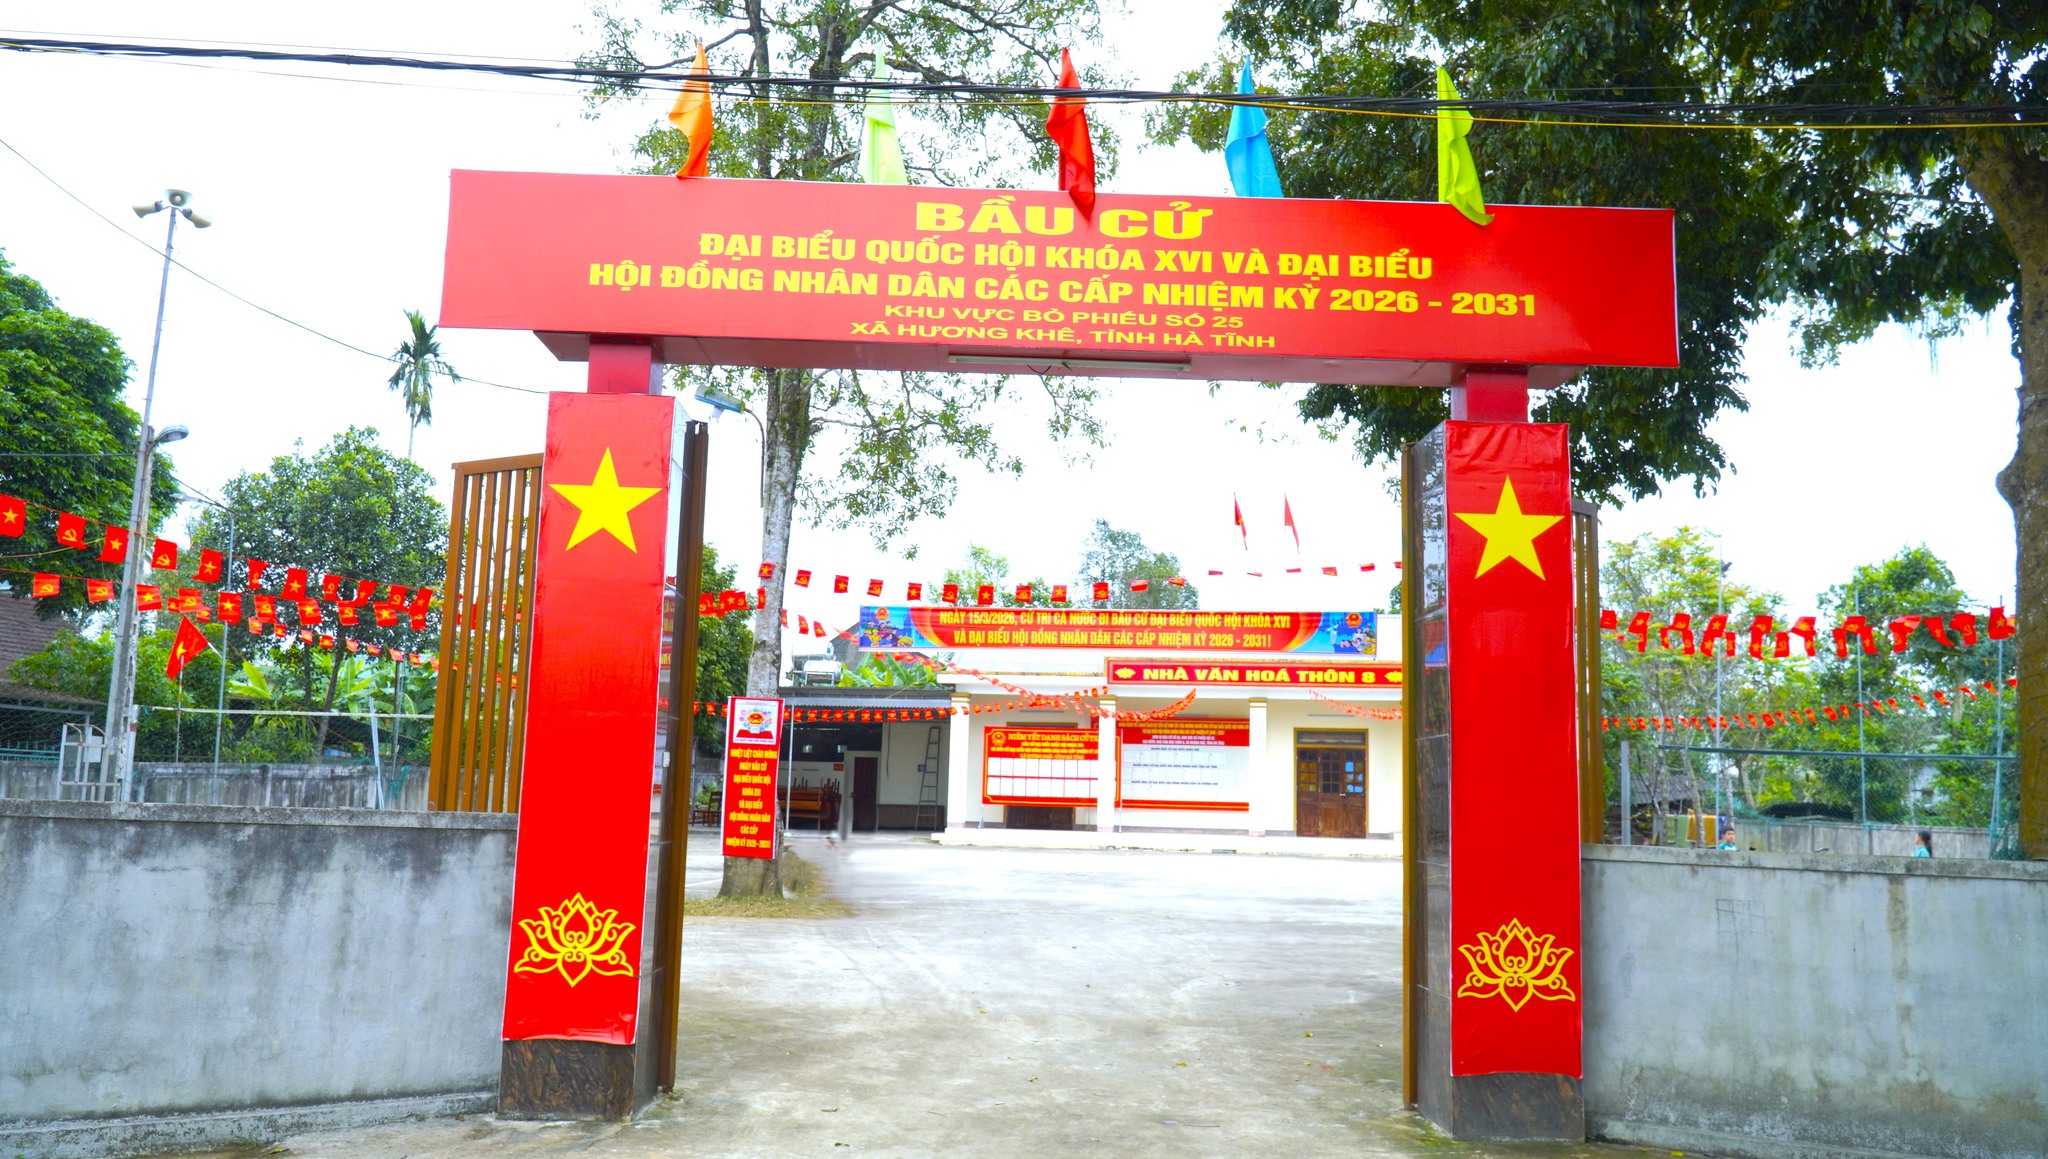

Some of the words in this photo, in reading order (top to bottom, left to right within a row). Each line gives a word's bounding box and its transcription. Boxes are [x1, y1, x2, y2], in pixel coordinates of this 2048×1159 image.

[916, 196, 1074, 235] BẦU
[1100, 201, 1213, 239] CỬ
[699, 233, 762, 262] ĐẠI
[772, 230, 855, 260] BIỂU
[866, 235, 964, 264] QUỐC
[974, 240, 1036, 267] HỘI
[1046, 244, 1144, 270] KHÓA
[1154, 250, 1212, 272] XVI
[1222, 248, 1269, 274] VÀ
[1277, 253, 1340, 278] ĐẠI
[1350, 249, 1431, 279] BIỂU
[590, 260, 651, 291] HỘI
[660, 260, 763, 290] ĐỒNG
[774, 268, 878, 296] NHÂN
[888, 271, 964, 298] DÂN
[975, 274, 1048, 301] CÁC
[1060, 275, 1132, 303] CẤP
[1144, 281, 1263, 311] NHIỆM
[1274, 284, 1320, 309] KỲ
[1330, 289, 1418, 312] 2026
[1452, 293, 1534, 315] 2031
[886, 305, 944, 318] KHU
[952, 308, 1014, 322] VỰC
[1024, 309, 1064, 322] BỎ
[1073, 311, 1156, 325] PHIẾU
[1165, 313, 1205, 327] SỐ
[1213, 316, 1243, 328] 25
[851, 321, 890, 335] XÃ
[898, 324, 1007, 339] HƯƠNG
[1017, 327, 1081, 344] KHÊ,
[1090, 329, 1154, 344] TỈNH
[1164, 331, 1203, 345] HÀ
[1210, 333, 1274, 347] TĨNH
[940, 609, 966, 624] NGÀY
[969, 612, 1018, 626] 15/3/2026,
[1036, 613, 1051, 625] TRI
[1150, 614, 1166, 629] ĐẠI
[1274, 616, 1291, 628] XVI
[954, 628, 966, 644] VÀ
[969, 631, 985, 646] ĐẠI
[988, 626, 1009, 644] BIỂU
[1012, 629, 1028, 647] HỘI
[1031, 627, 1058, 645] ĐỒNG
[1060, 629, 1088, 645] NHÂN
[1091, 630, 1111, 645] DÂN
[1114, 630, 1133, 646] CÁC
[1136, 629, 1156, 646] CẤP
[1159, 631, 1191, 649] NHIỆM
[1194, 631, 1207, 647] KỲ
[1209, 633, 1234, 647] 2026
[1243, 634, 1271, 648] 2031!
[1144, 667, 1188, 680] NHÀ
[1195, 668, 1238, 681] VĂN
[1246, 669, 1290, 682] HOÁ
[1297, 669, 1355, 682] THÔN
[1362, 672, 1375, 683] 8
